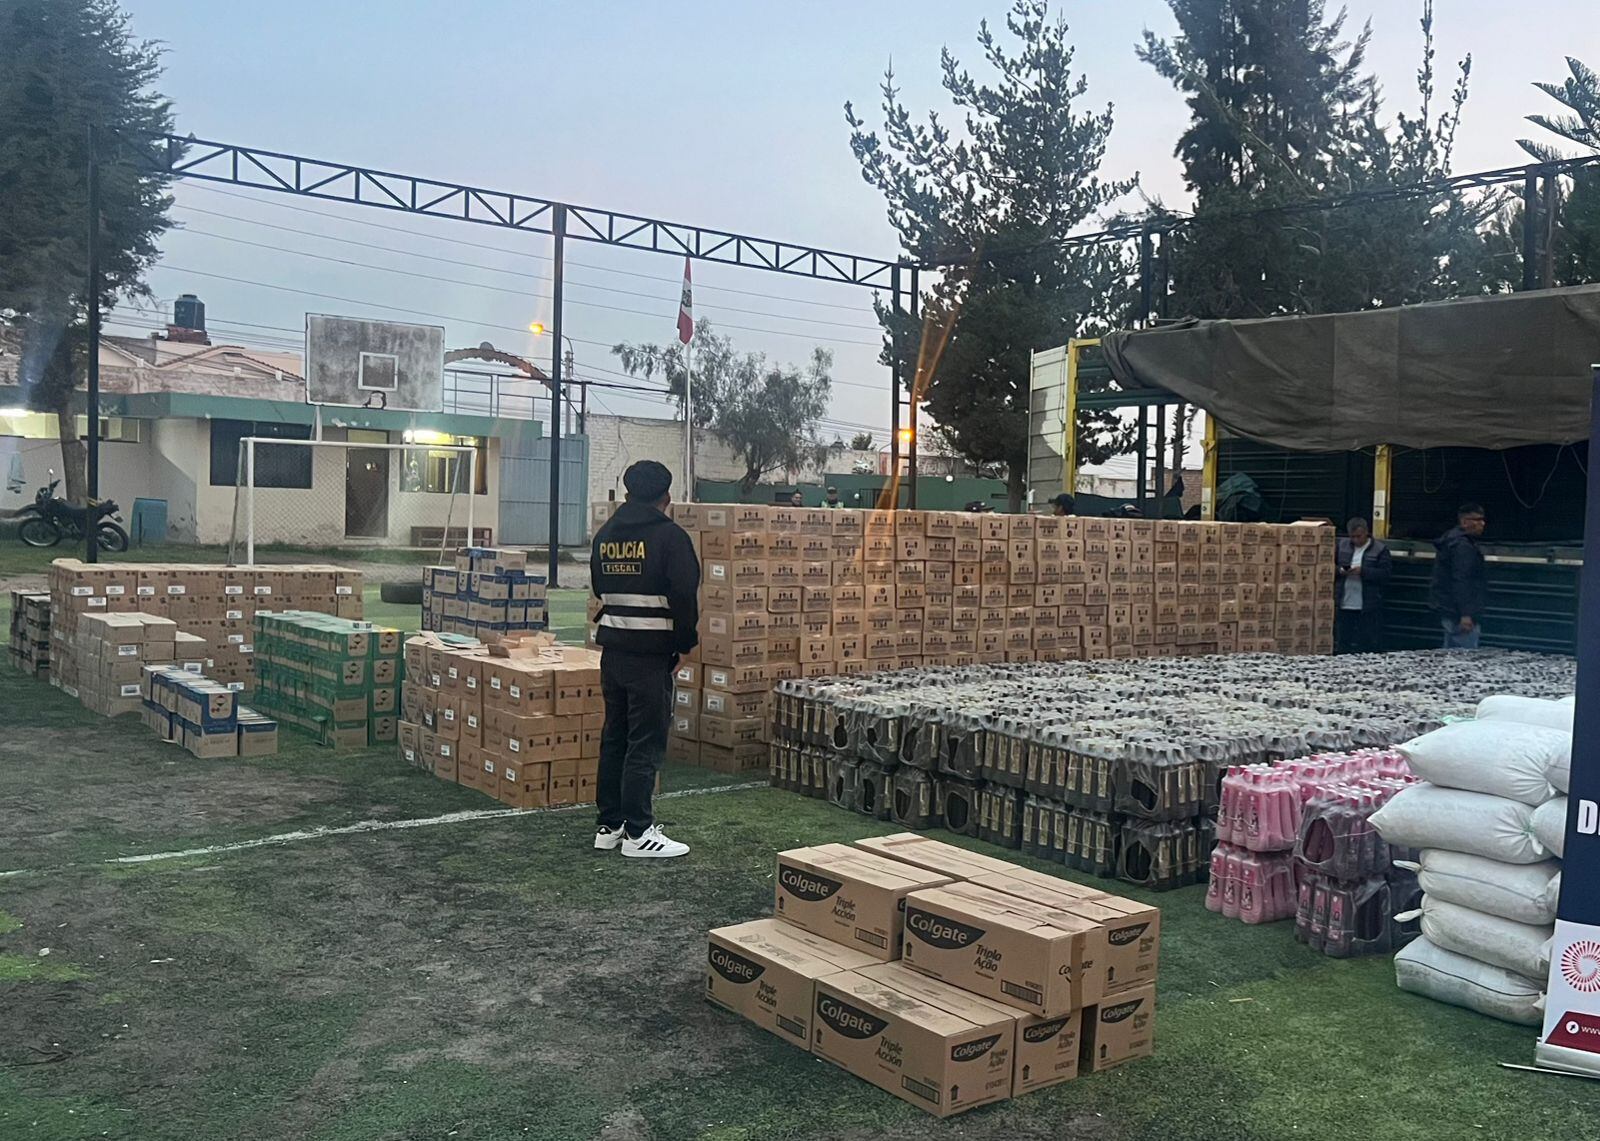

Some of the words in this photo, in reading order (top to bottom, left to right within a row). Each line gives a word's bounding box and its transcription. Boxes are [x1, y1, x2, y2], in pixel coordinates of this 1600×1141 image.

[600, 541, 645, 559] POLICÍA
[606, 564, 637, 573] FISCAL
[1577, 799, 1600, 836] D
[781, 869, 829, 897] Colgate
[835, 895, 856, 911] Triple
[831, 905, 856, 921] Acción
[909, 913, 968, 944] Colgate
[1110, 927, 1142, 941] Colgate
[711, 949, 754, 979] Colgate
[974, 956, 998, 972] Ação
[1058, 960, 1094, 976] Coate
[759, 979, 777, 996] Triple
[819, 999, 873, 1035] Colgate
[1102, 1004, 1135, 1019] Colgate
[1025, 1023, 1061, 1039] Colgate
[880, 1035, 903, 1056] Triple
[953, 1041, 992, 1058] Colgate
[874, 1047, 903, 1068] Acción
